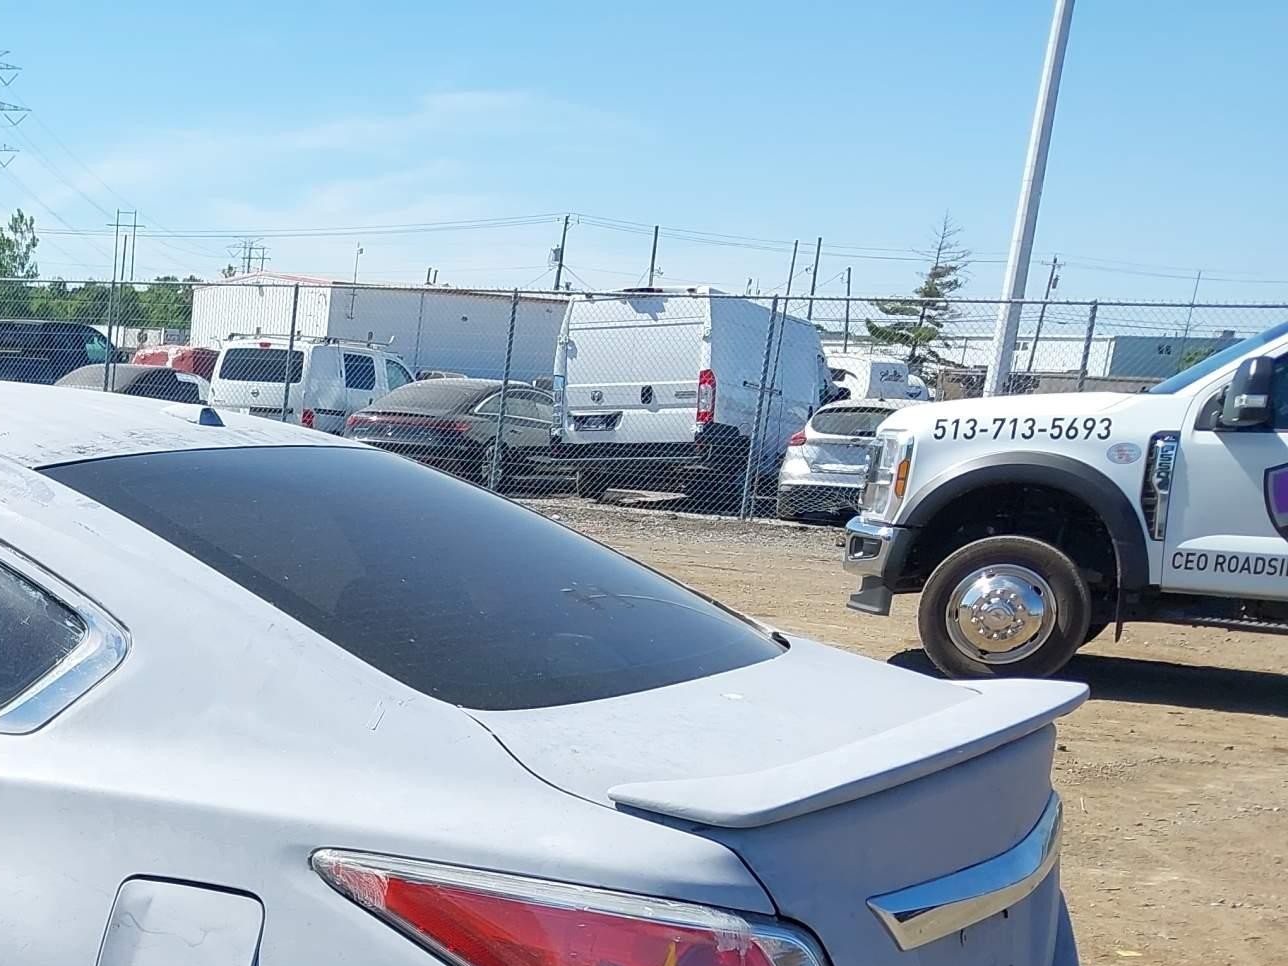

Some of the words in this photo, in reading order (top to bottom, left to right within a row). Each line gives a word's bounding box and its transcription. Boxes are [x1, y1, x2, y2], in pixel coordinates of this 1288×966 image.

[933, 417, 1113, 440] 513-713-5693
[1172, 551, 1209, 571] CEO
[1214, 554, 1288, 577] ROADSI
